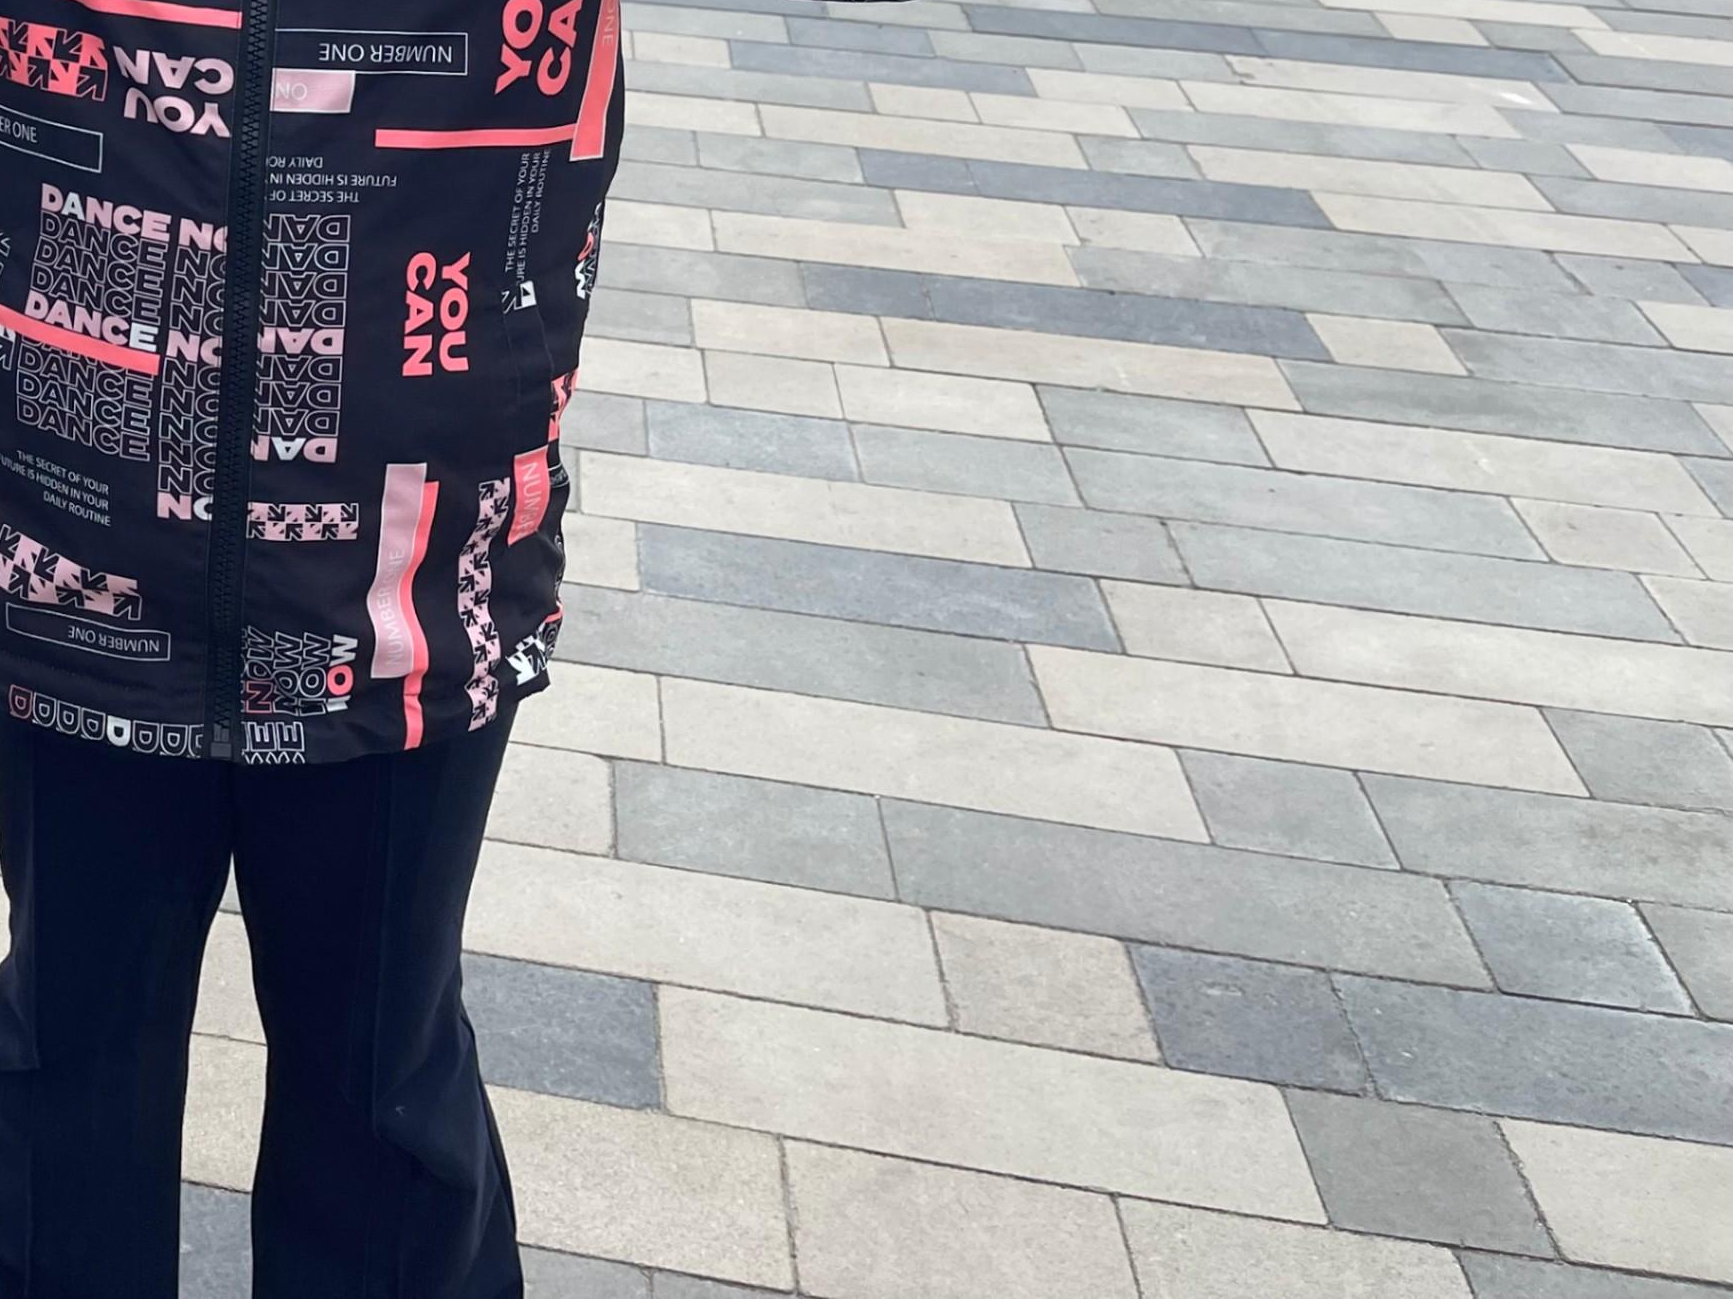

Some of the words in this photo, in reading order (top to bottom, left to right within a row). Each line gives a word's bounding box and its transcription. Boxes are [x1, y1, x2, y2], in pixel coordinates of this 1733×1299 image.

[319, 43, 364, 61] ONE
[371, 44, 452, 63] NUMBER
[112, 45, 235, 96] CAN
[123, 87, 233, 138] YOU
[12, 121, 38, 144] ONE
[288, 156, 323, 168] DAILY
[517, 153, 530, 185] YOUR
[528, 152, 540, 185] YOUR
[270, 173, 283, 185] IN
[286, 173, 334, 186] HIDDEN
[337, 174, 348, 186] IS
[351, 174, 397, 187] FUTURE
[526, 186, 534, 198] IN
[41, 182, 171, 241] DANCE
[289, 190, 334, 202] SECRET
[337, 191, 360, 202] THE
[514, 189, 524, 203] OF
[508, 206, 520, 248] SECRET
[519, 201, 532, 247] HIDDEN
[531, 202, 541, 233] DAILY
[41, 212, 169, 269] DANCE
[518, 248, 526, 258] IS
[33, 236, 165, 298] DANCE
[505, 251, 515, 273] THE
[31, 263, 162, 324] DANCE
[25, 290, 159, 351] DANCE
[402, 252, 436, 376] CAN
[439, 252, 470, 372] YOU
[18, 344, 152, 404] DANCE
[17, 369, 152, 434] DANCE
[18, 396, 150, 461] DANCE
[17, 450, 35, 465] THE
[36, 457, 67, 478] SECRET
[68, 471, 81, 483] OF
[82, 477, 109, 495] YOUR
[27, 469, 35, 480] IS
[36, 472, 68, 495] HIDDEN
[70, 488, 81, 500] IN
[82, 491, 109, 511] YOUR
[43, 490, 68, 510] DAILY
[68, 503, 112, 527] ROUTINE
[67, 625, 96, 643] ONE
[99, 632, 159, 653] NUMBER
[378, 587, 404, 667] NUMBER
